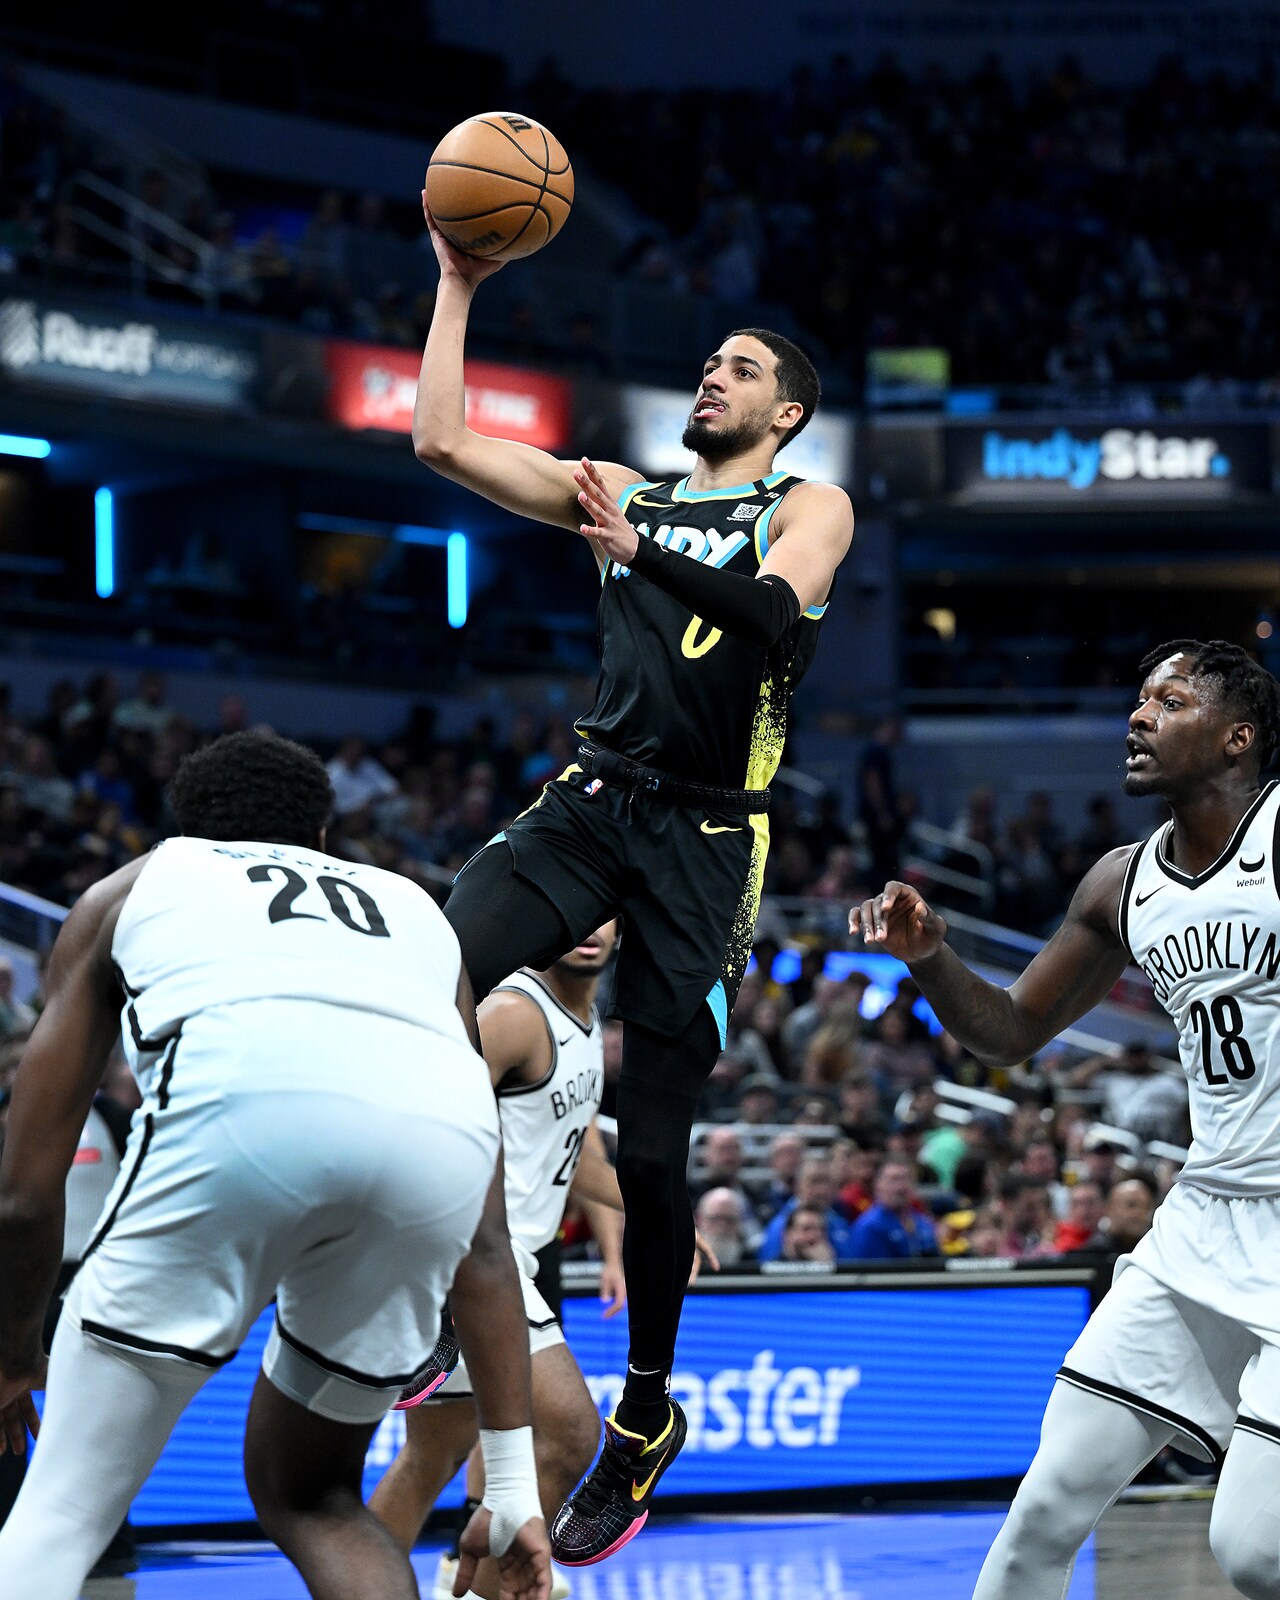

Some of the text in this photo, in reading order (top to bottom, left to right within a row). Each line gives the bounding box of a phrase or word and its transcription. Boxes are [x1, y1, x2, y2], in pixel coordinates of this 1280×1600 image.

[246, 864, 391, 938] 20
[1236, 876, 1266, 888] Webull
[1144, 921, 1280, 1000] BROOKLYN
[1190, 995, 1256, 1085] 28
